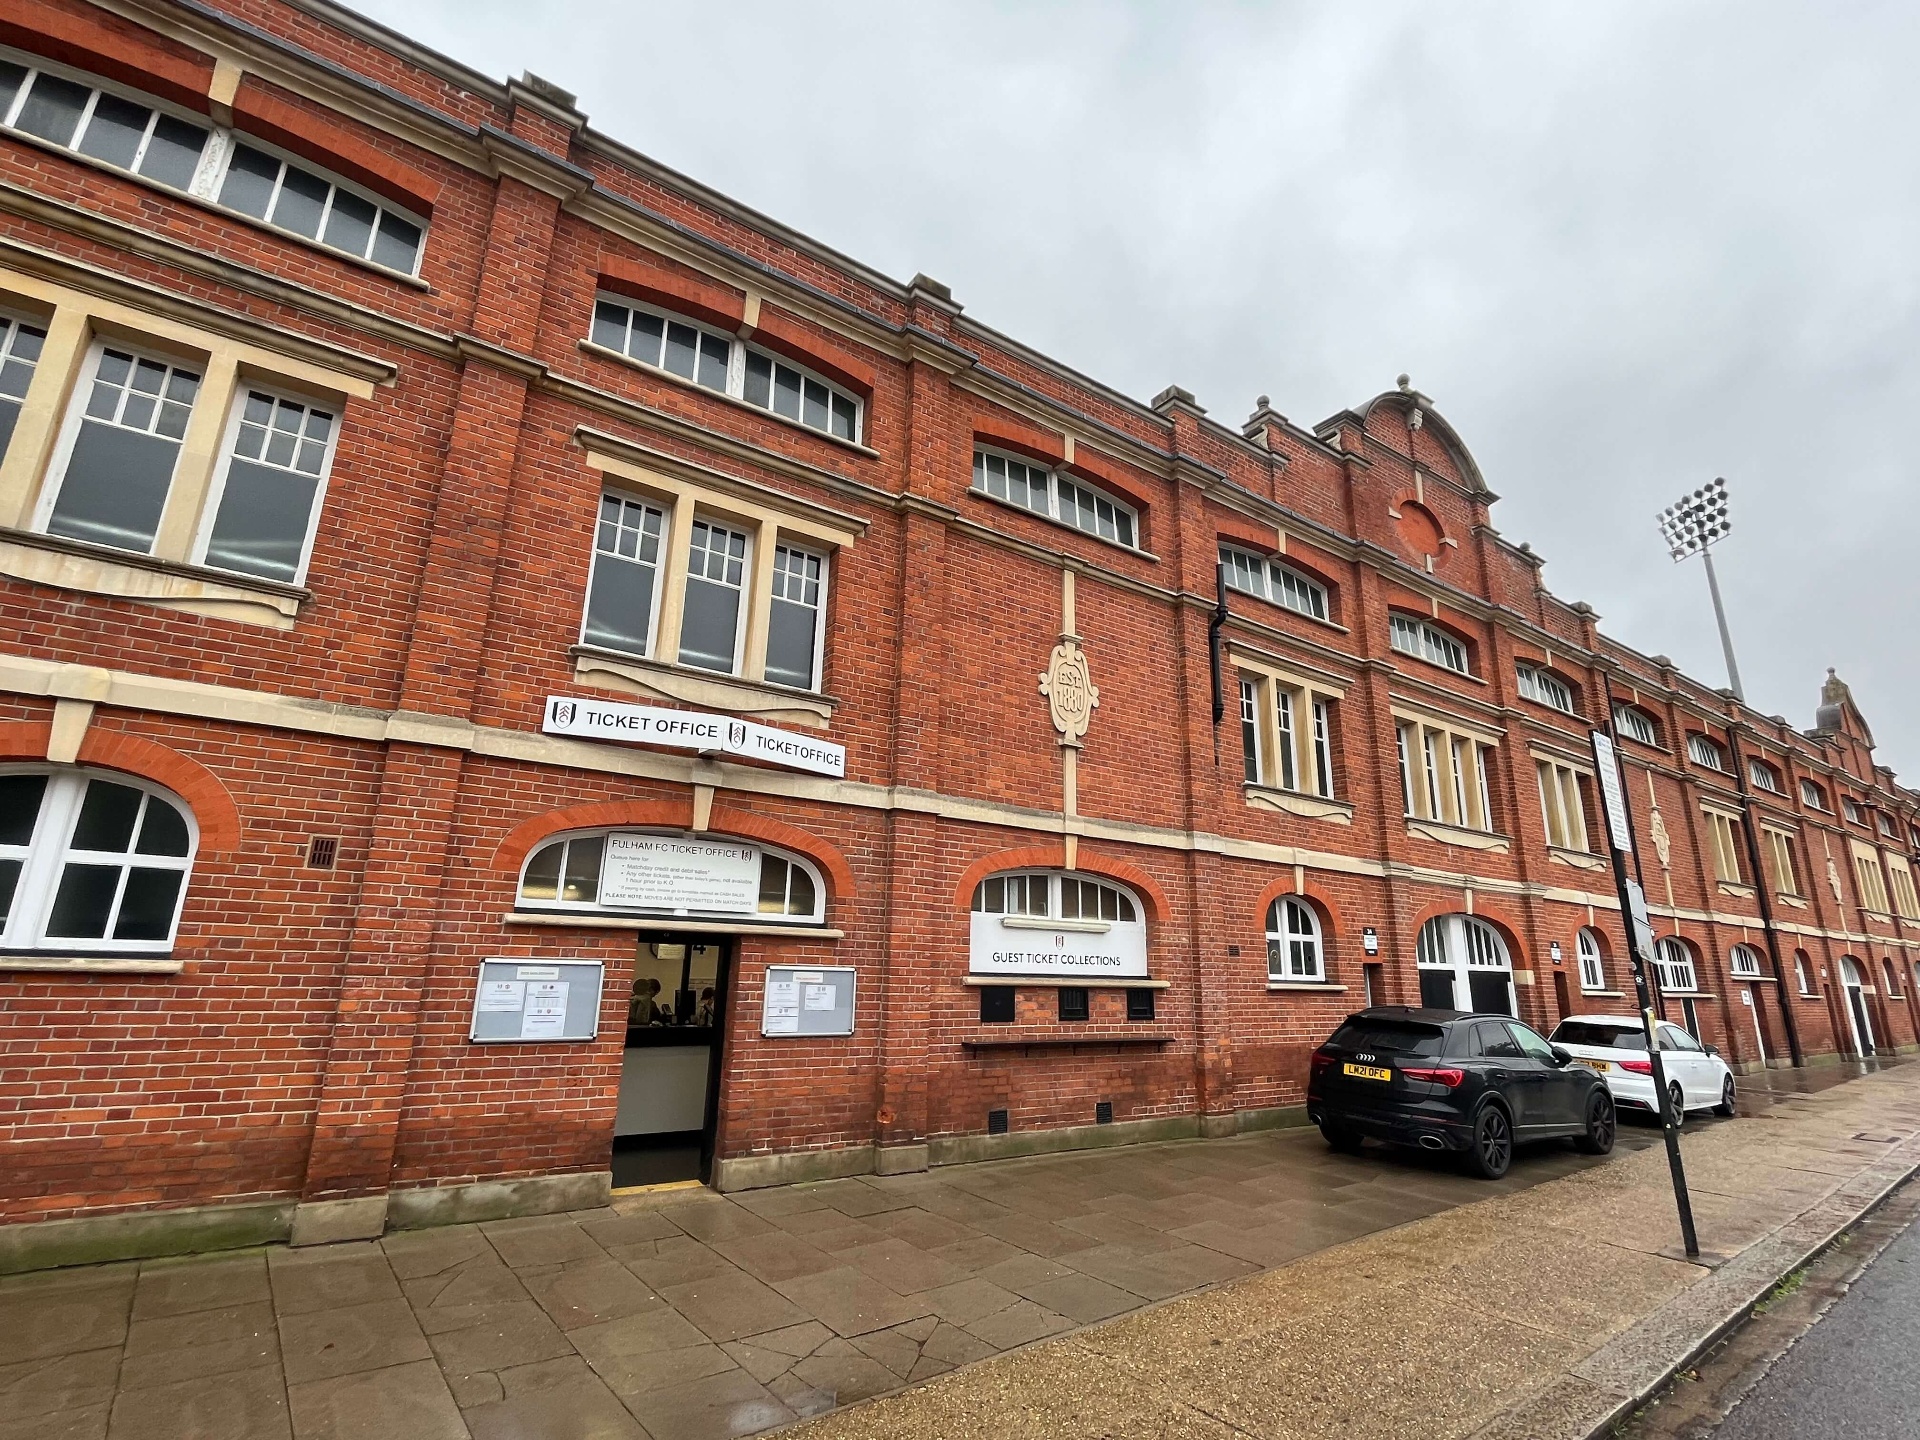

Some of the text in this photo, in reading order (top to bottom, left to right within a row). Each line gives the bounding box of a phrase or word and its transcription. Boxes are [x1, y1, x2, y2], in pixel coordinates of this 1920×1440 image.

[586, 711, 718, 738] TICKET OFFICE
[756, 735, 841, 767] TICKET OFFICE
[612, 839, 738, 858] FULHAM FC TICKET OFFICE
[992, 952, 1121, 966] GUEST TICKET COLLECTIONS
[1348, 1064, 1385, 1078] LM21 OFC
